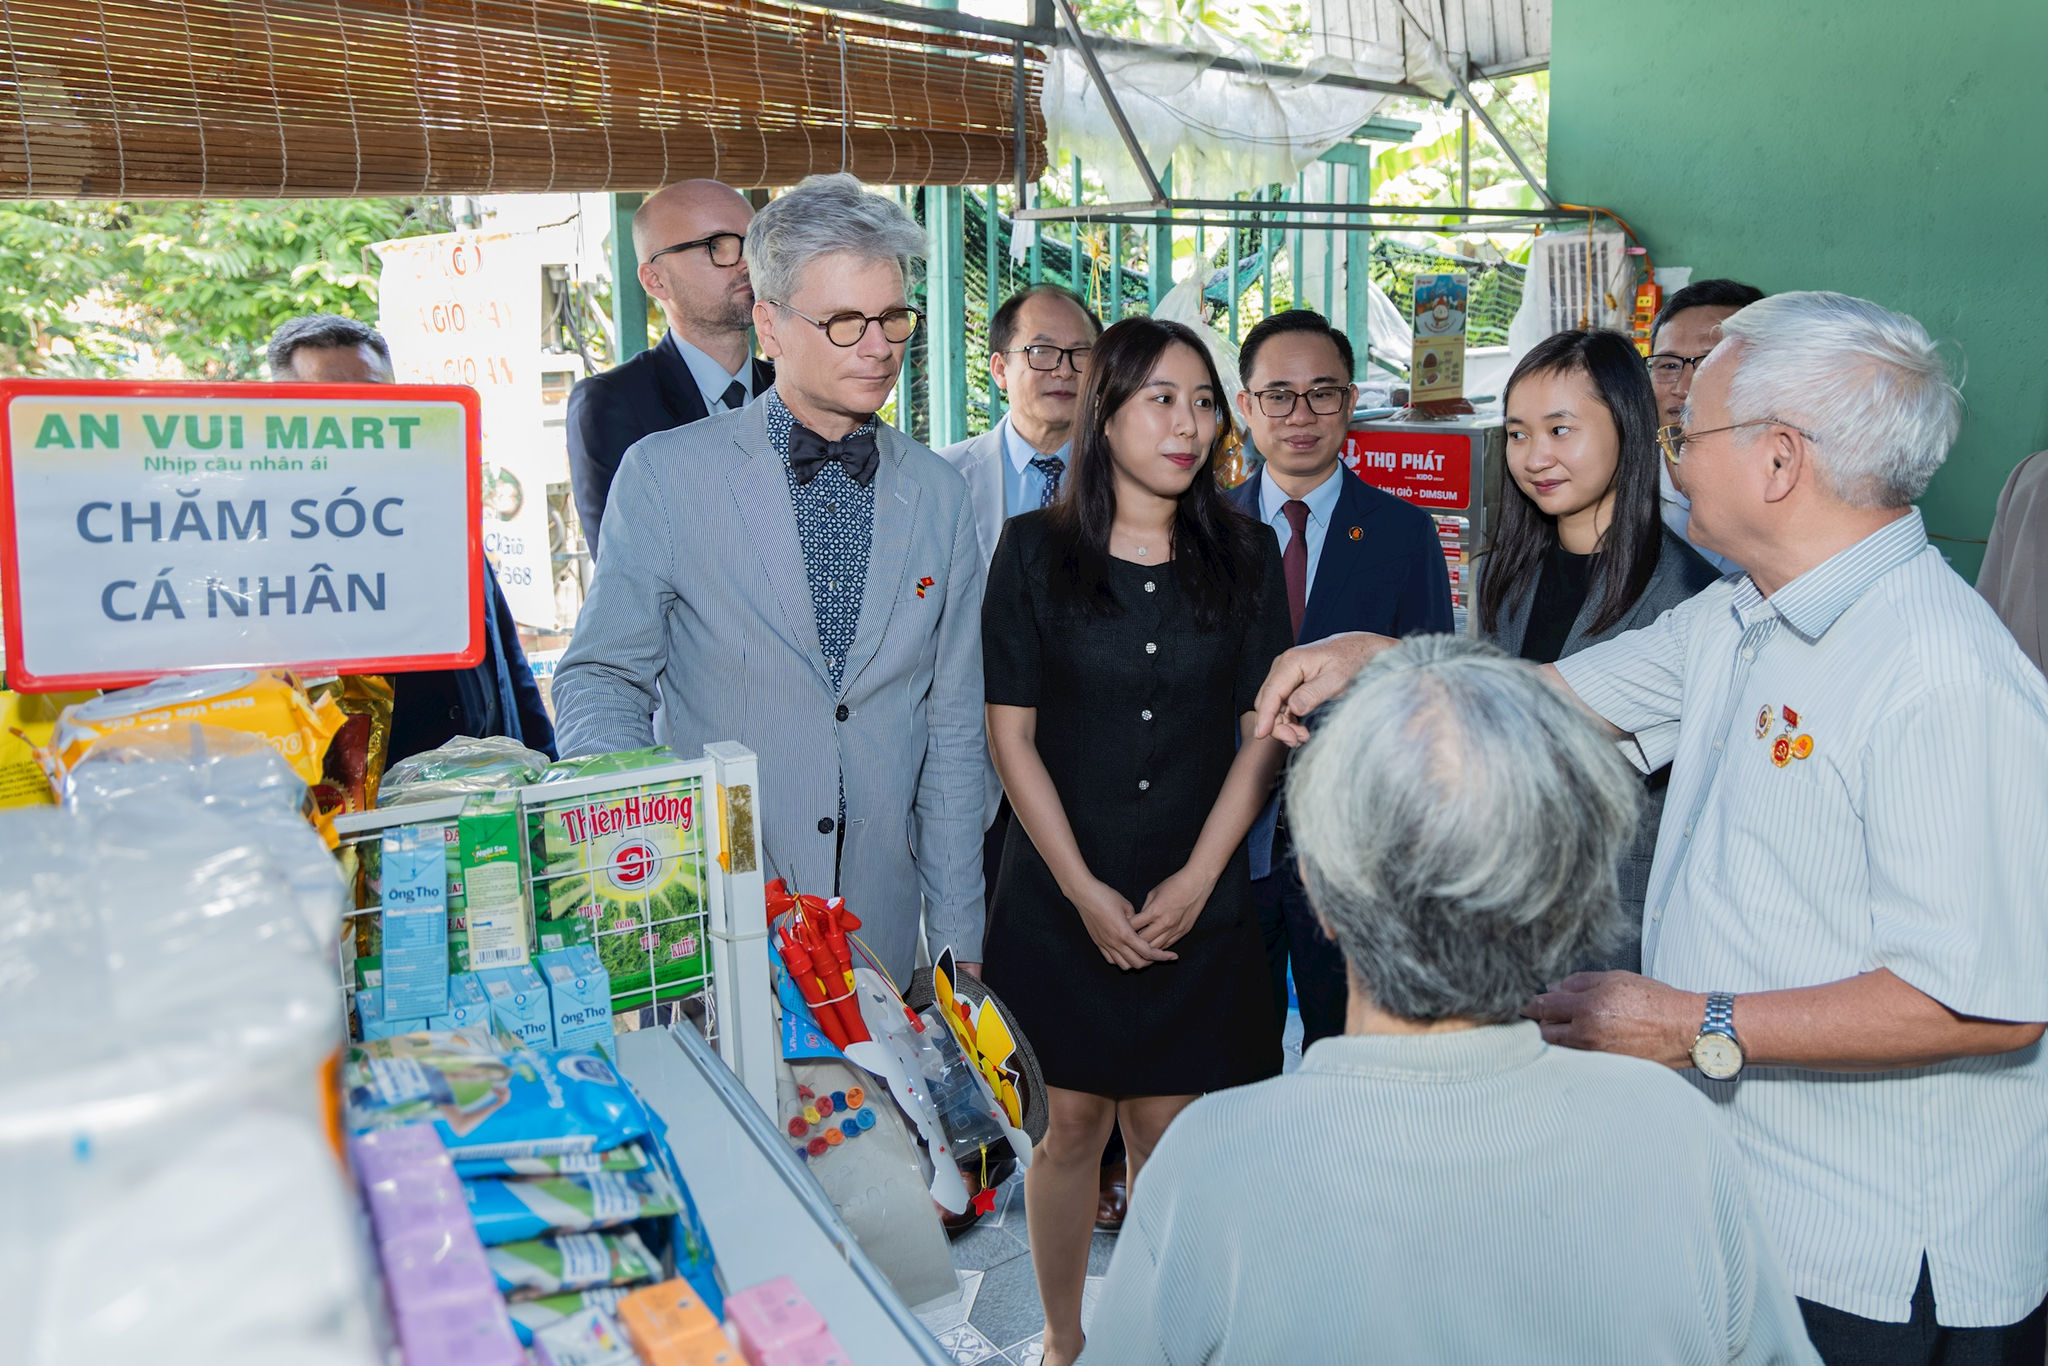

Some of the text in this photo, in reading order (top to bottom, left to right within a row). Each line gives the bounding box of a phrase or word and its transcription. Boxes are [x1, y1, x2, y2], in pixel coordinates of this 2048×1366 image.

[36, 413, 422, 451] AN VUI MART
[144, 456, 197, 475] Nhịp
[249, 456, 304, 471] nhân
[310, 456, 328, 471] ái
[1365, 450, 1445, 472] THỌ PHÁT
[1420, 489, 1458, 500] DIMSUM
[77, 486, 405, 544] CHĂM SÓC
[101, 562, 387, 623] CÁ NHÂN
[560, 795, 693, 846] Thiên Hương
[616, 846, 655, 884] 9
[388, 886, 439, 903] Ông Thọ
[560, 1006, 606, 1025] Ông Thọ
[523, 1023, 546, 1035] Thọ
